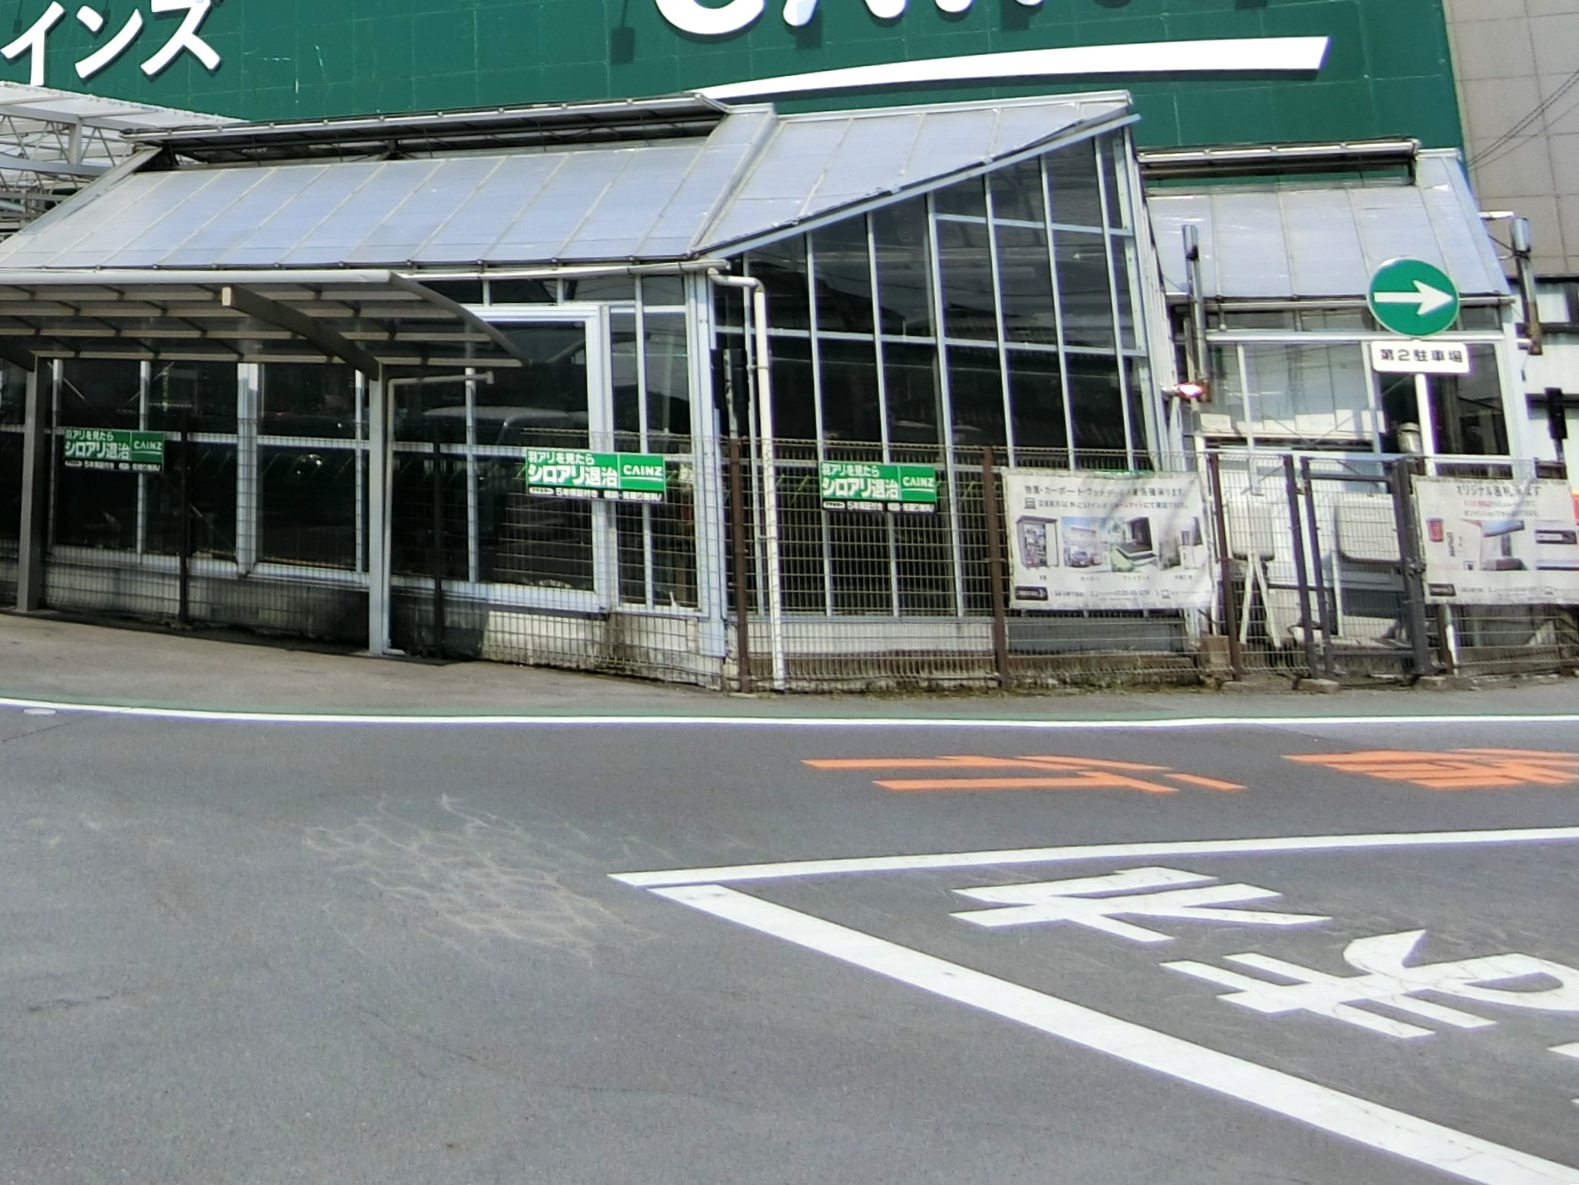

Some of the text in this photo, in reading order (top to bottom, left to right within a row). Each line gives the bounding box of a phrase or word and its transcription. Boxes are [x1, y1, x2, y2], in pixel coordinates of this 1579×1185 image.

[1380, 349, 1463, 363] 第2駐車場
[64, 441, 130, 460] シロアリ退治
[133, 441, 162, 450] CAINZ
[528, 464, 619, 488] シロアリ退治
[623, 465, 663, 476] CAINZ
[822, 477, 899, 500] シロアリ退治
[902, 477, 934, 487] CAINZ
